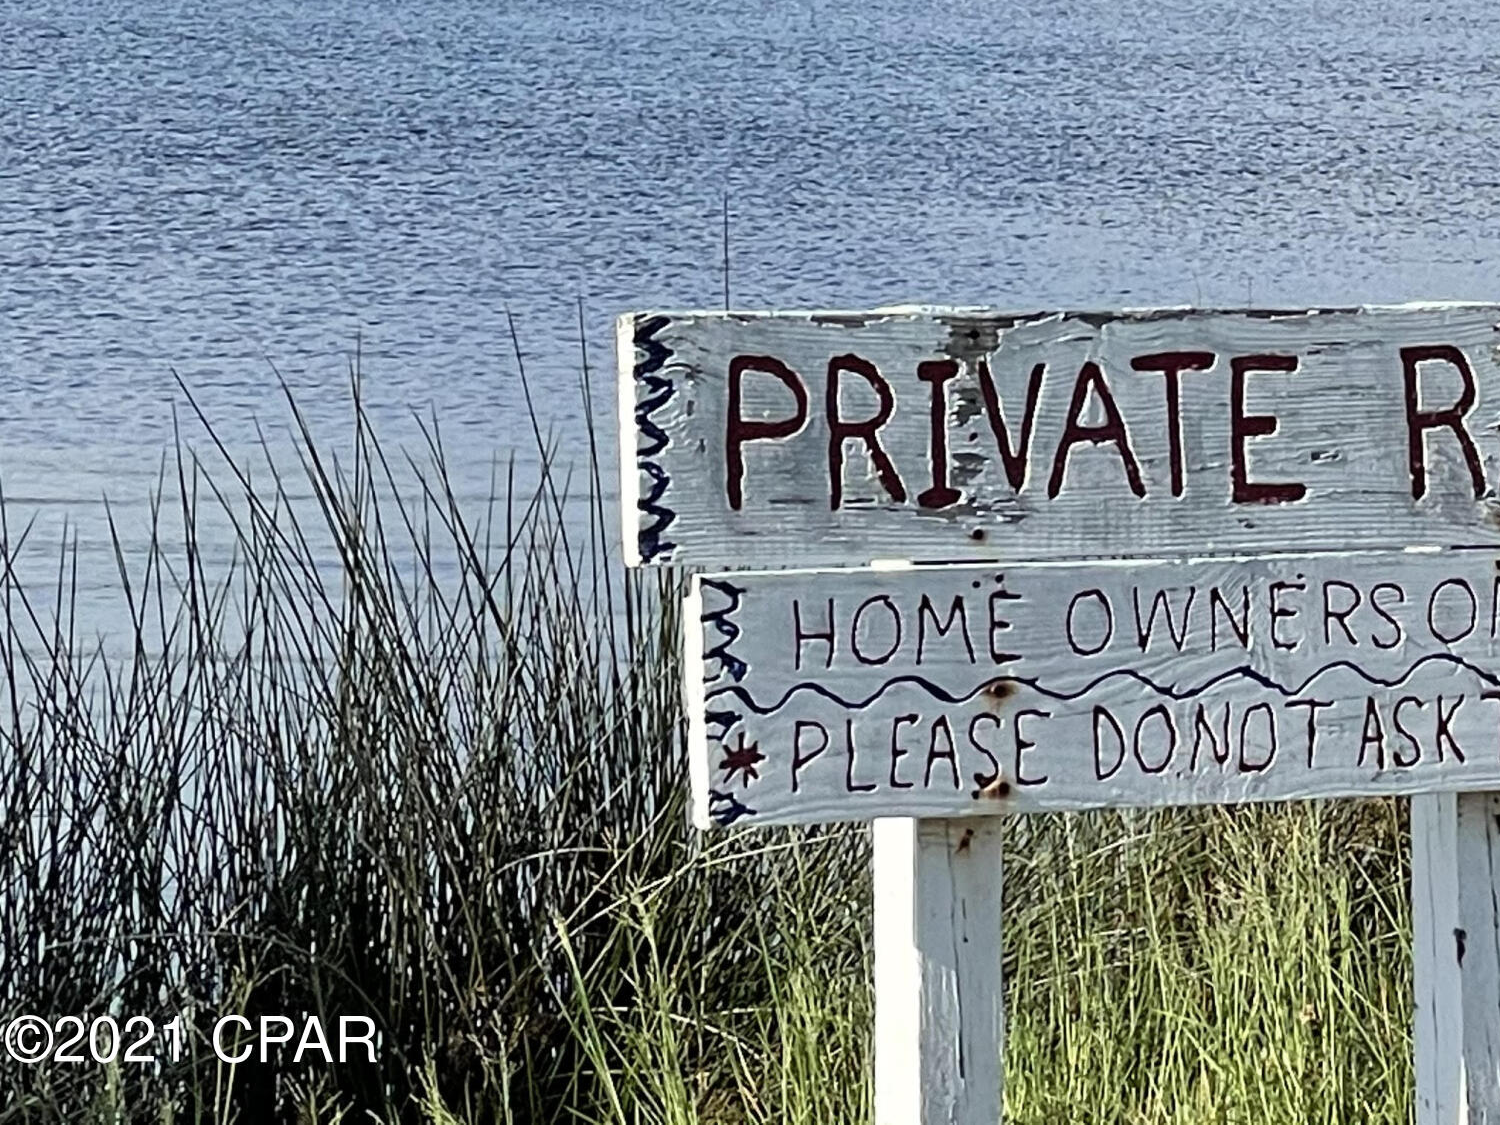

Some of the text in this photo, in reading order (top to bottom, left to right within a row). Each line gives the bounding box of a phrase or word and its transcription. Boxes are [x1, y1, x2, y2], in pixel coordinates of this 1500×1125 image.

[725, 352, 1306, 510] PRIVATE
[794, 589, 1022, 669] HOME
[792, 709, 1051, 792] PLEASE
[1357, 692, 1465, 770] ASK
